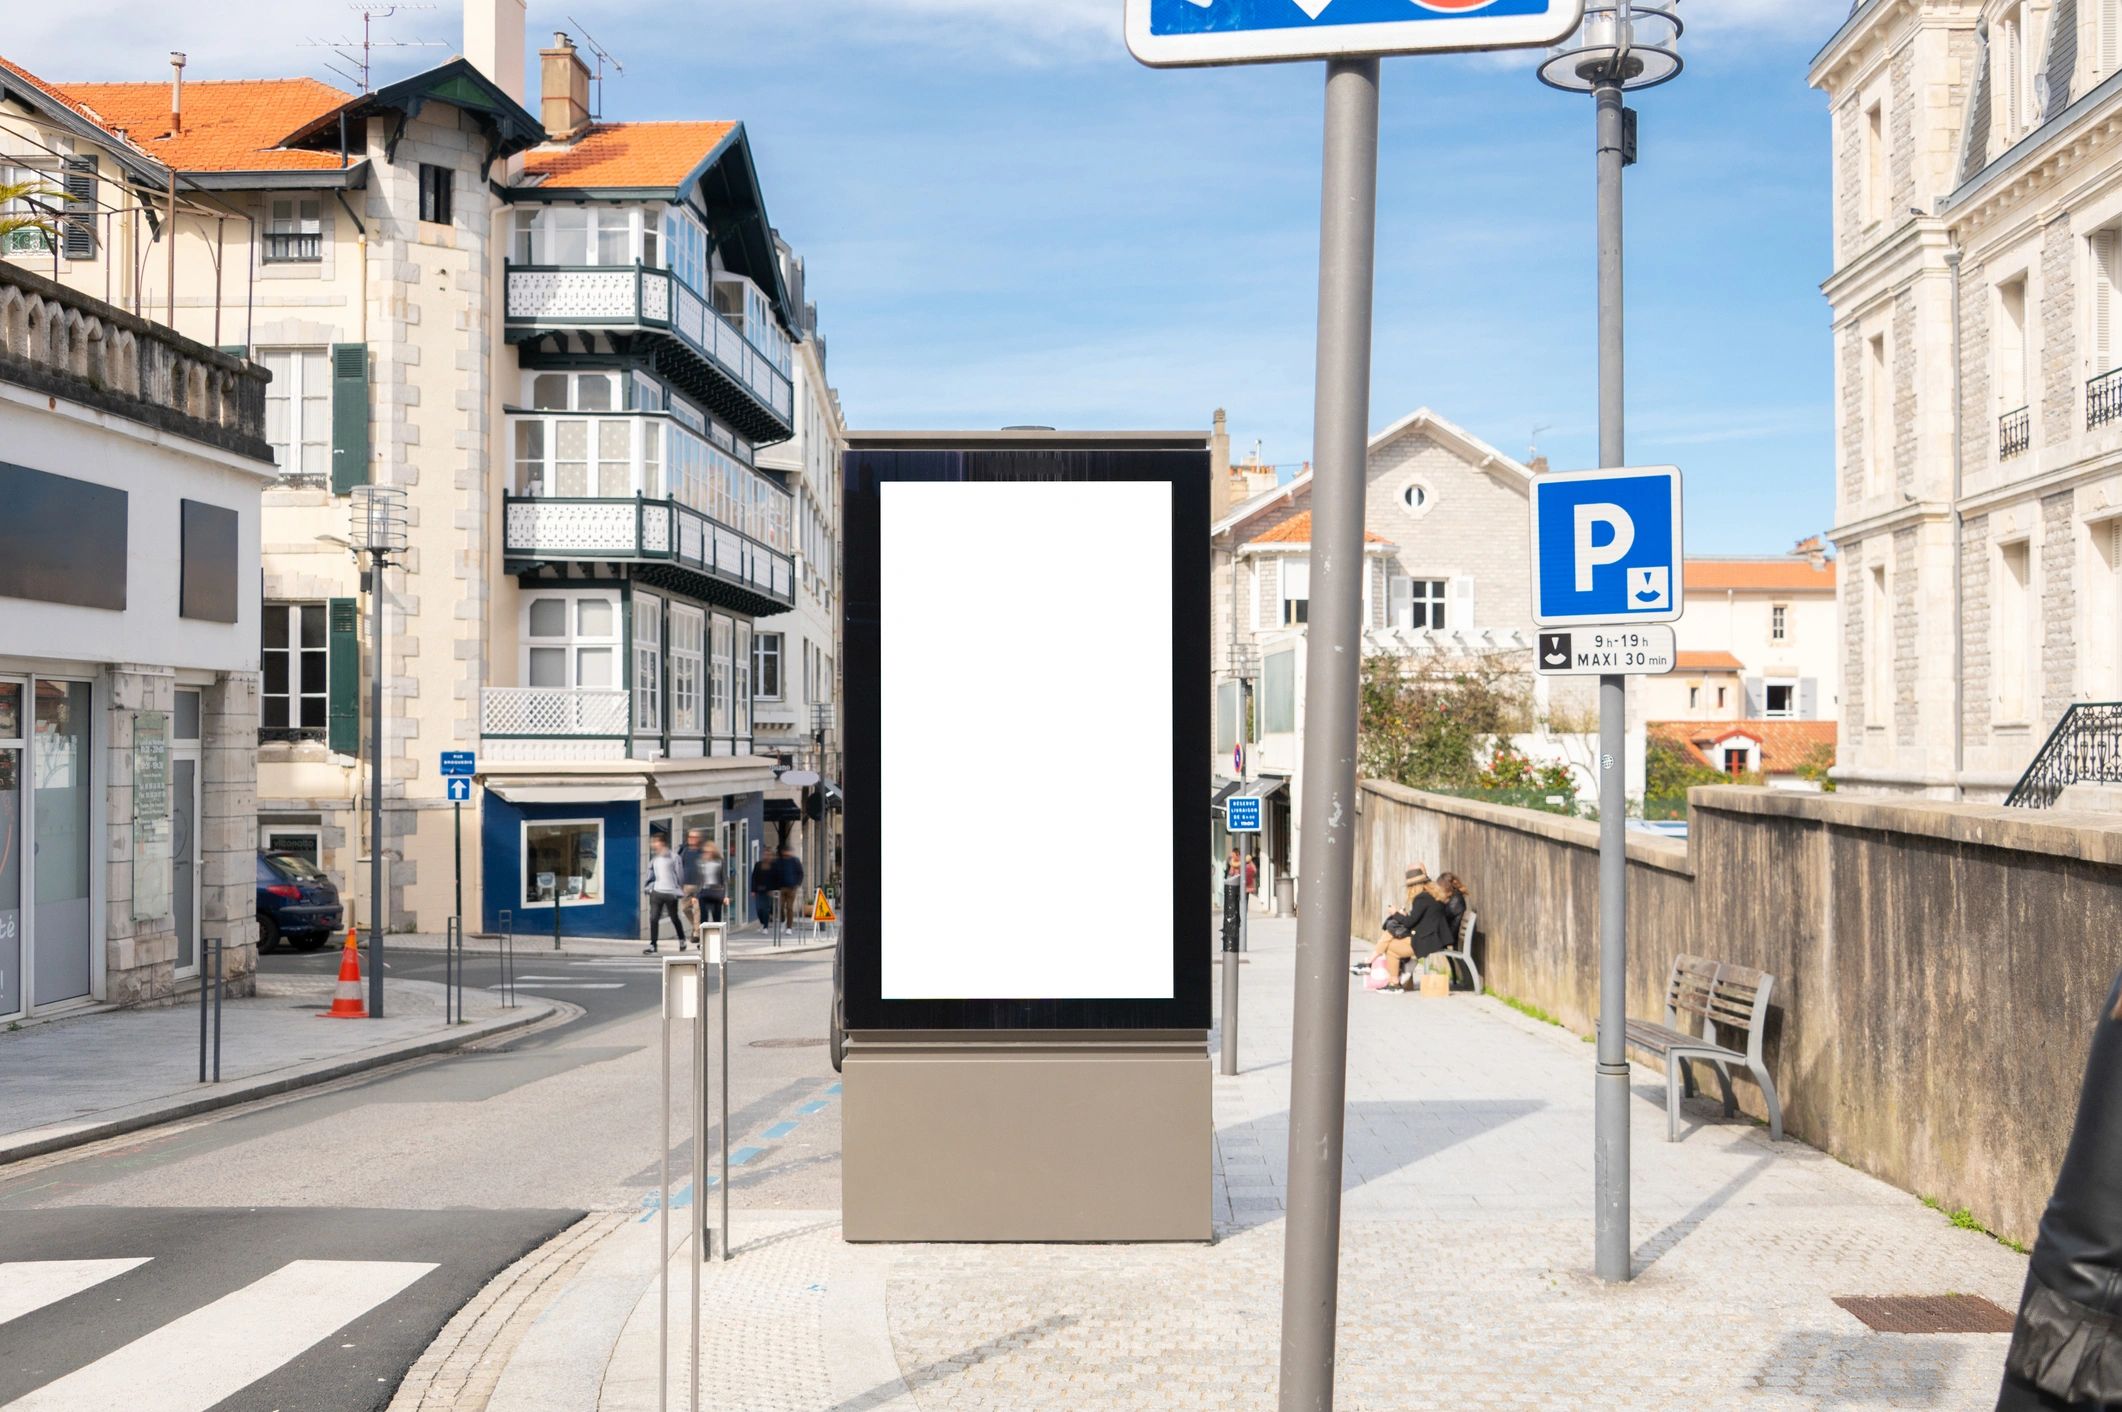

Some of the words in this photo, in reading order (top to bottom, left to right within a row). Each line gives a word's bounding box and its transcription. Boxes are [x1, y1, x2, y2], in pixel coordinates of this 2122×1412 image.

[1573, 502, 1635, 592] P
[1577, 653, 1617, 666] MAXI
[1625, 652, 1645, 665] 30
[1648, 655, 1667, 665] min
